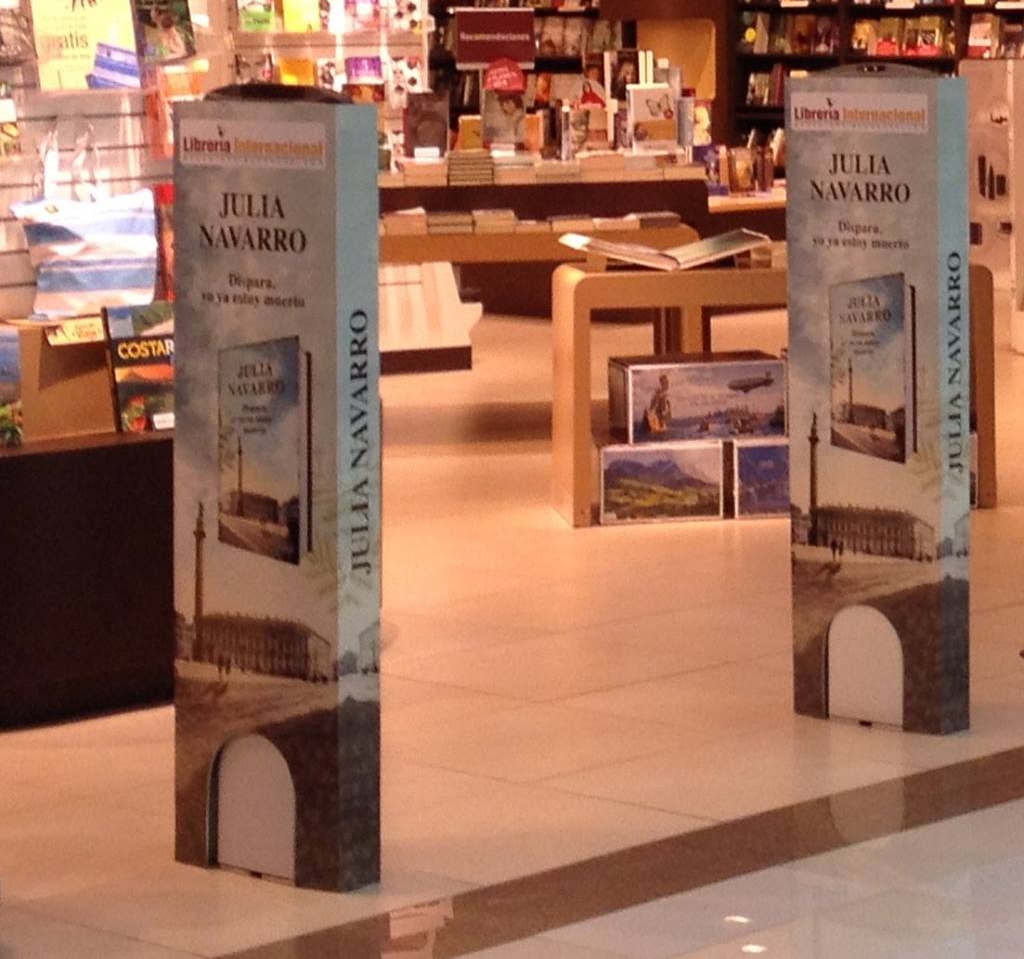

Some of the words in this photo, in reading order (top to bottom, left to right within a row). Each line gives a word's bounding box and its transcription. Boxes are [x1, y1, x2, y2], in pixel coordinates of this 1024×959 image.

[829, 153, 891, 175] JULIA
[219, 192, 285, 219] JULIA
[810, 181, 911, 203] NAVARRO
[200, 225, 306, 254] NAVARRO
[947, 252, 962, 386] NAVARRO
[350, 310, 369, 470] NAVARRO
[948, 393, 963, 473] JULIA
[351, 478, 372, 575] JULIA
